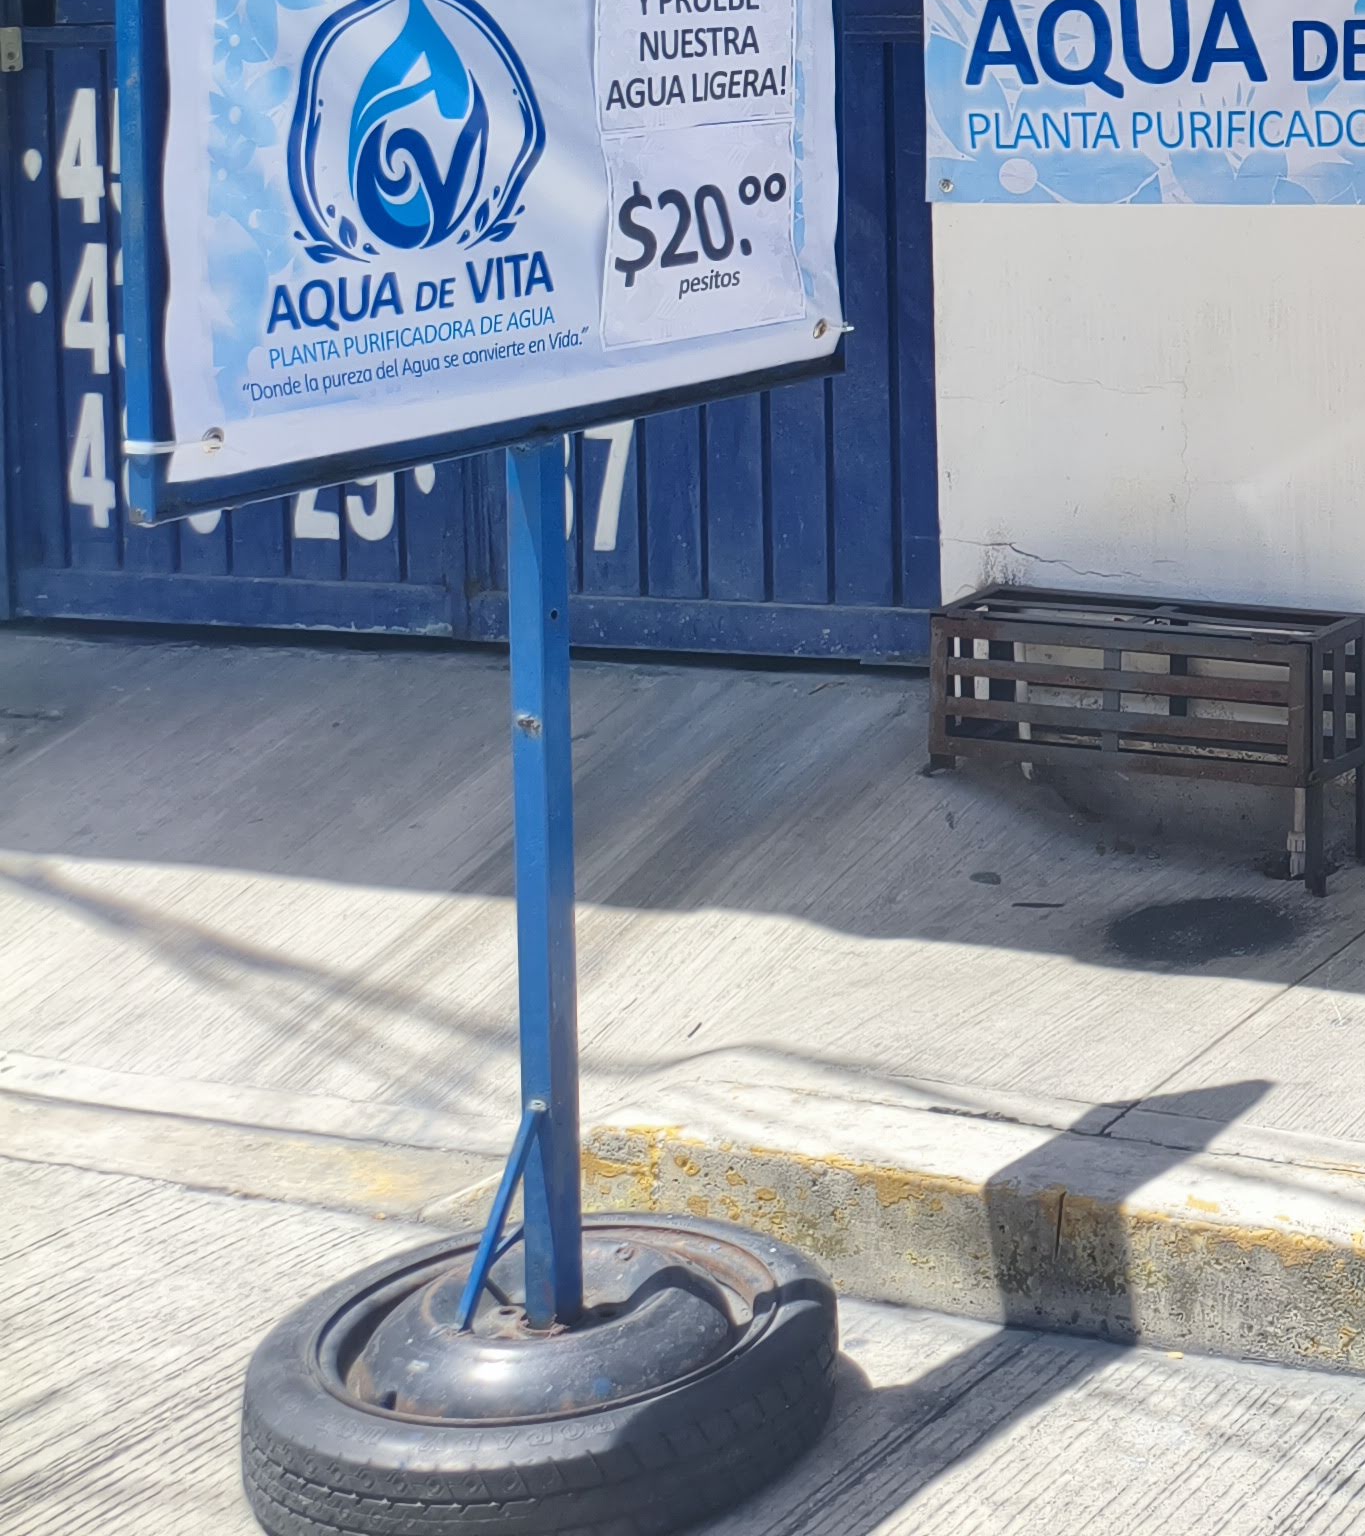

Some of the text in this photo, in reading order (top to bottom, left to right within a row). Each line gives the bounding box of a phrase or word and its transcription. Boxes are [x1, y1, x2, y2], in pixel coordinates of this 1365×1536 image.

[640, 26, 760, 62] NUESTRA
[606, 65, 787, 111] AGUA LIGERA!
[968, 111, 1120, 149] PLANTA
[266, 251, 555, 334] AQUA DE VITA
[678, 269, 741, 300] pesitos
[269, 306, 556, 369] PLANTA PURIFICADORA DE AGUA
[305, 373, 319, 392] la
[322, 369, 373, 395] pureza
[376, 364, 399, 387] del
[402, 357, 440, 378] Agua
[444, 353, 459, 368] se
[462, 343, 526, 365] convierte
[528, 340, 546, 354] en
